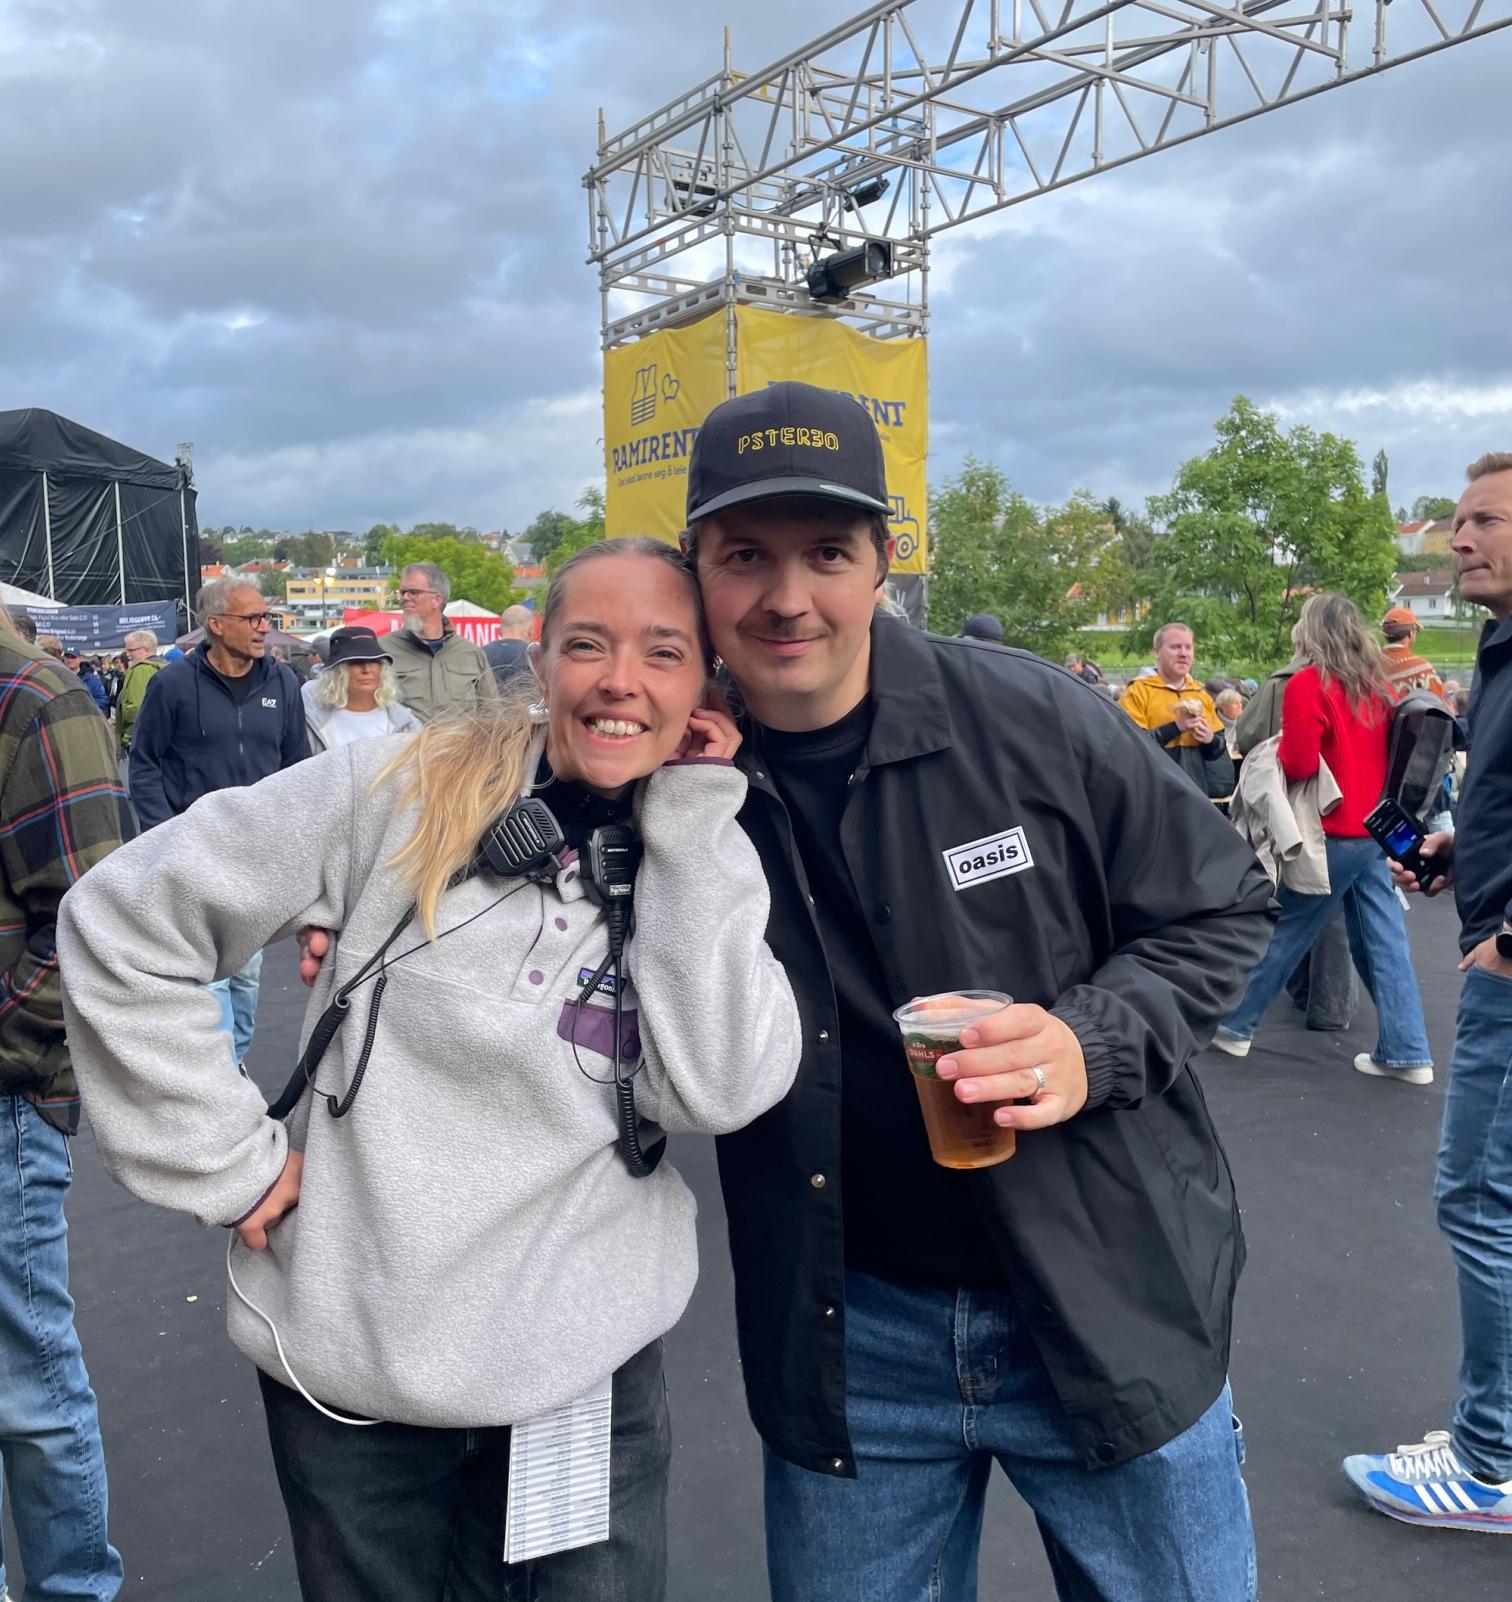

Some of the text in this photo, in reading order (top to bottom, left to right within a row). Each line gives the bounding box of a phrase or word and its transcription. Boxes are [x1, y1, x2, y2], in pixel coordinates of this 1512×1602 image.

[262, 697, 277, 707] EA7
[523, 817, 540, 843] MOTOROLA
[959, 844, 1019, 874] oasis
